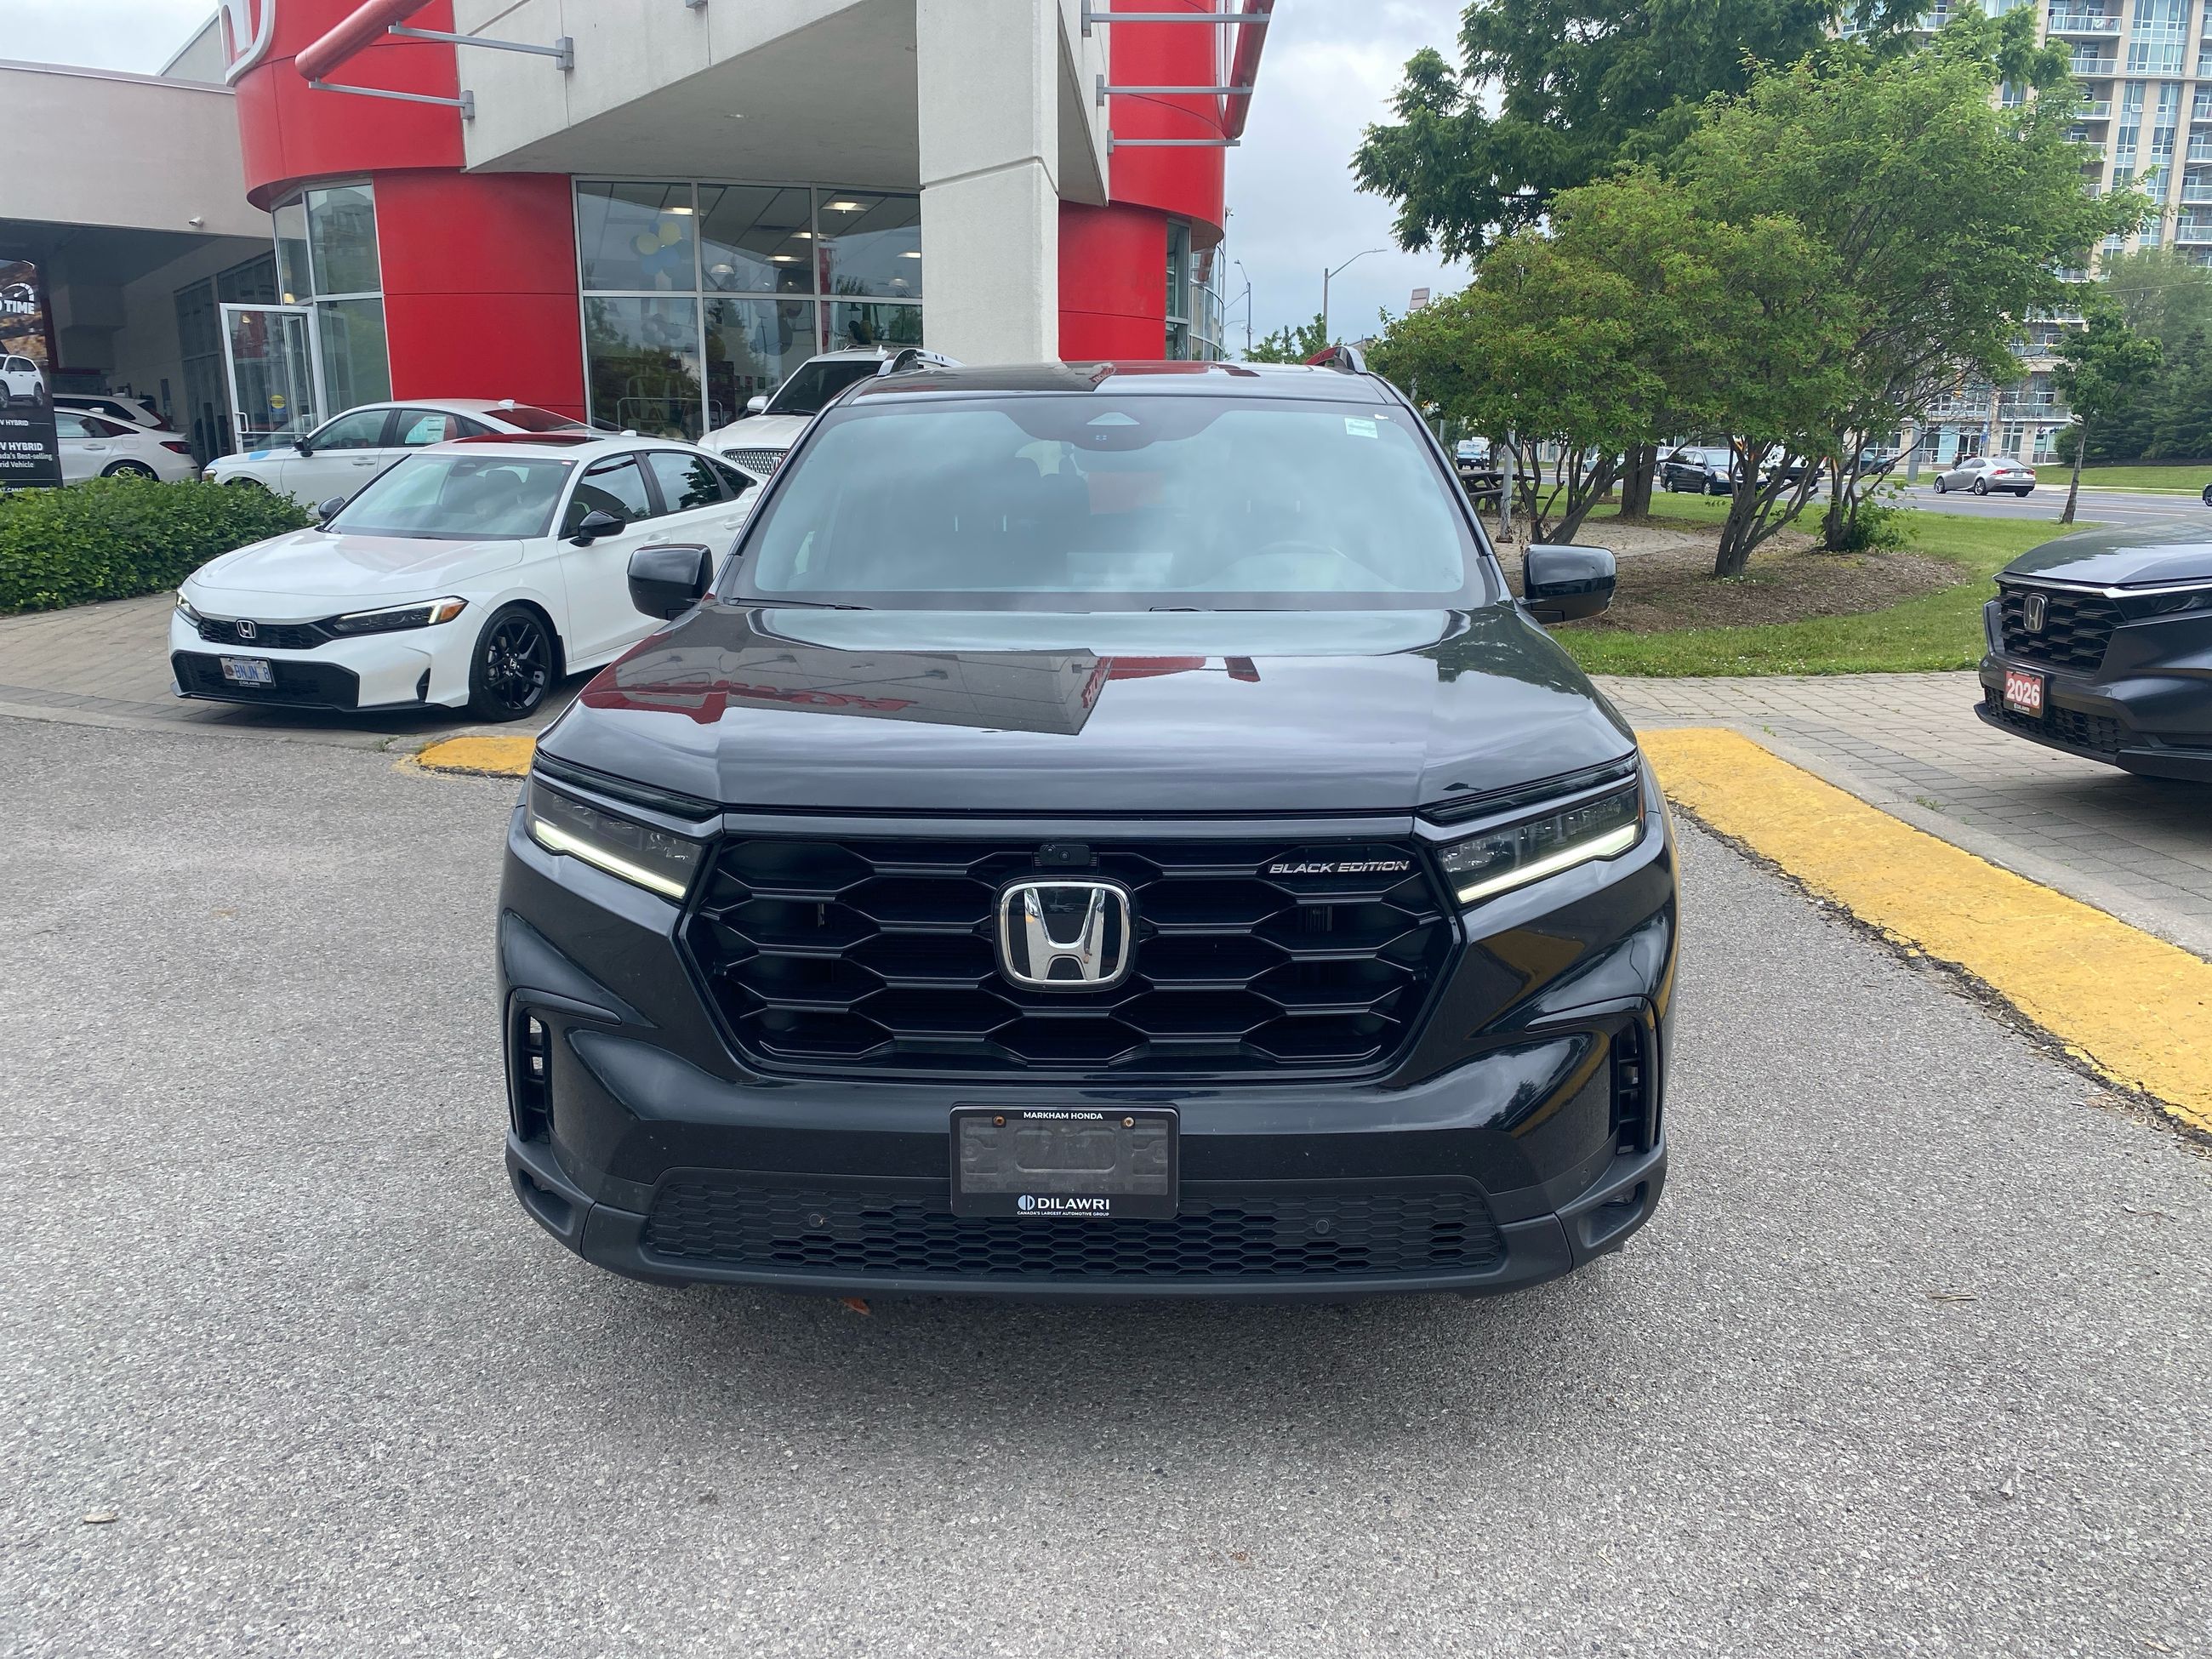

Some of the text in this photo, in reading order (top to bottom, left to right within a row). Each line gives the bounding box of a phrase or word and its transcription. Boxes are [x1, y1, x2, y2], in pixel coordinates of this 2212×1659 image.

[4, 299, 35, 315] TIME
[9, 442, 43, 451] HYBRID
[2006, 677, 2040, 706] 2026
[1268, 860, 1411, 874] BLACK EDITION
[1023, 1111, 1069, 1120] MARKHAM
[1037, 1197, 1110, 1210] DILAWRI
